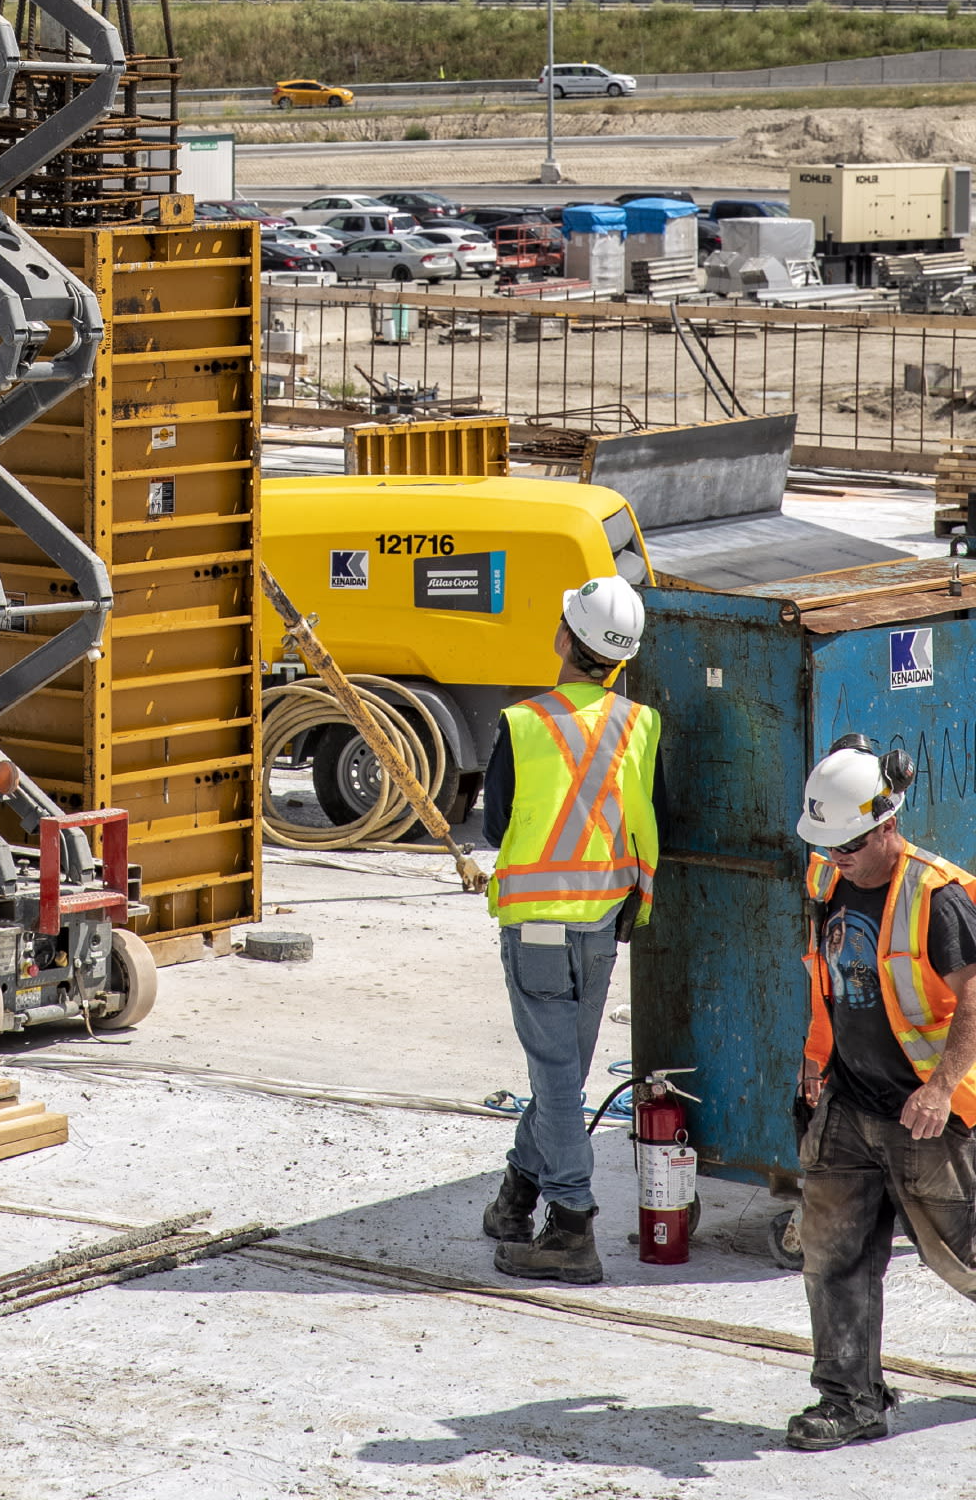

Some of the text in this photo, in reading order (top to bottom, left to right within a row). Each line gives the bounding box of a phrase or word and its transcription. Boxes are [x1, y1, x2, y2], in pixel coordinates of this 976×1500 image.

[799, 174, 833, 184] KOHLER
[855, 175, 880, 184] KOHLER
[376, 534, 455, 556] 121716
[331, 577, 367, 586] KENAIDAN
[427, 577, 479, 589] Atlas Copco
[891, 669, 933, 685] KENAIDAN
